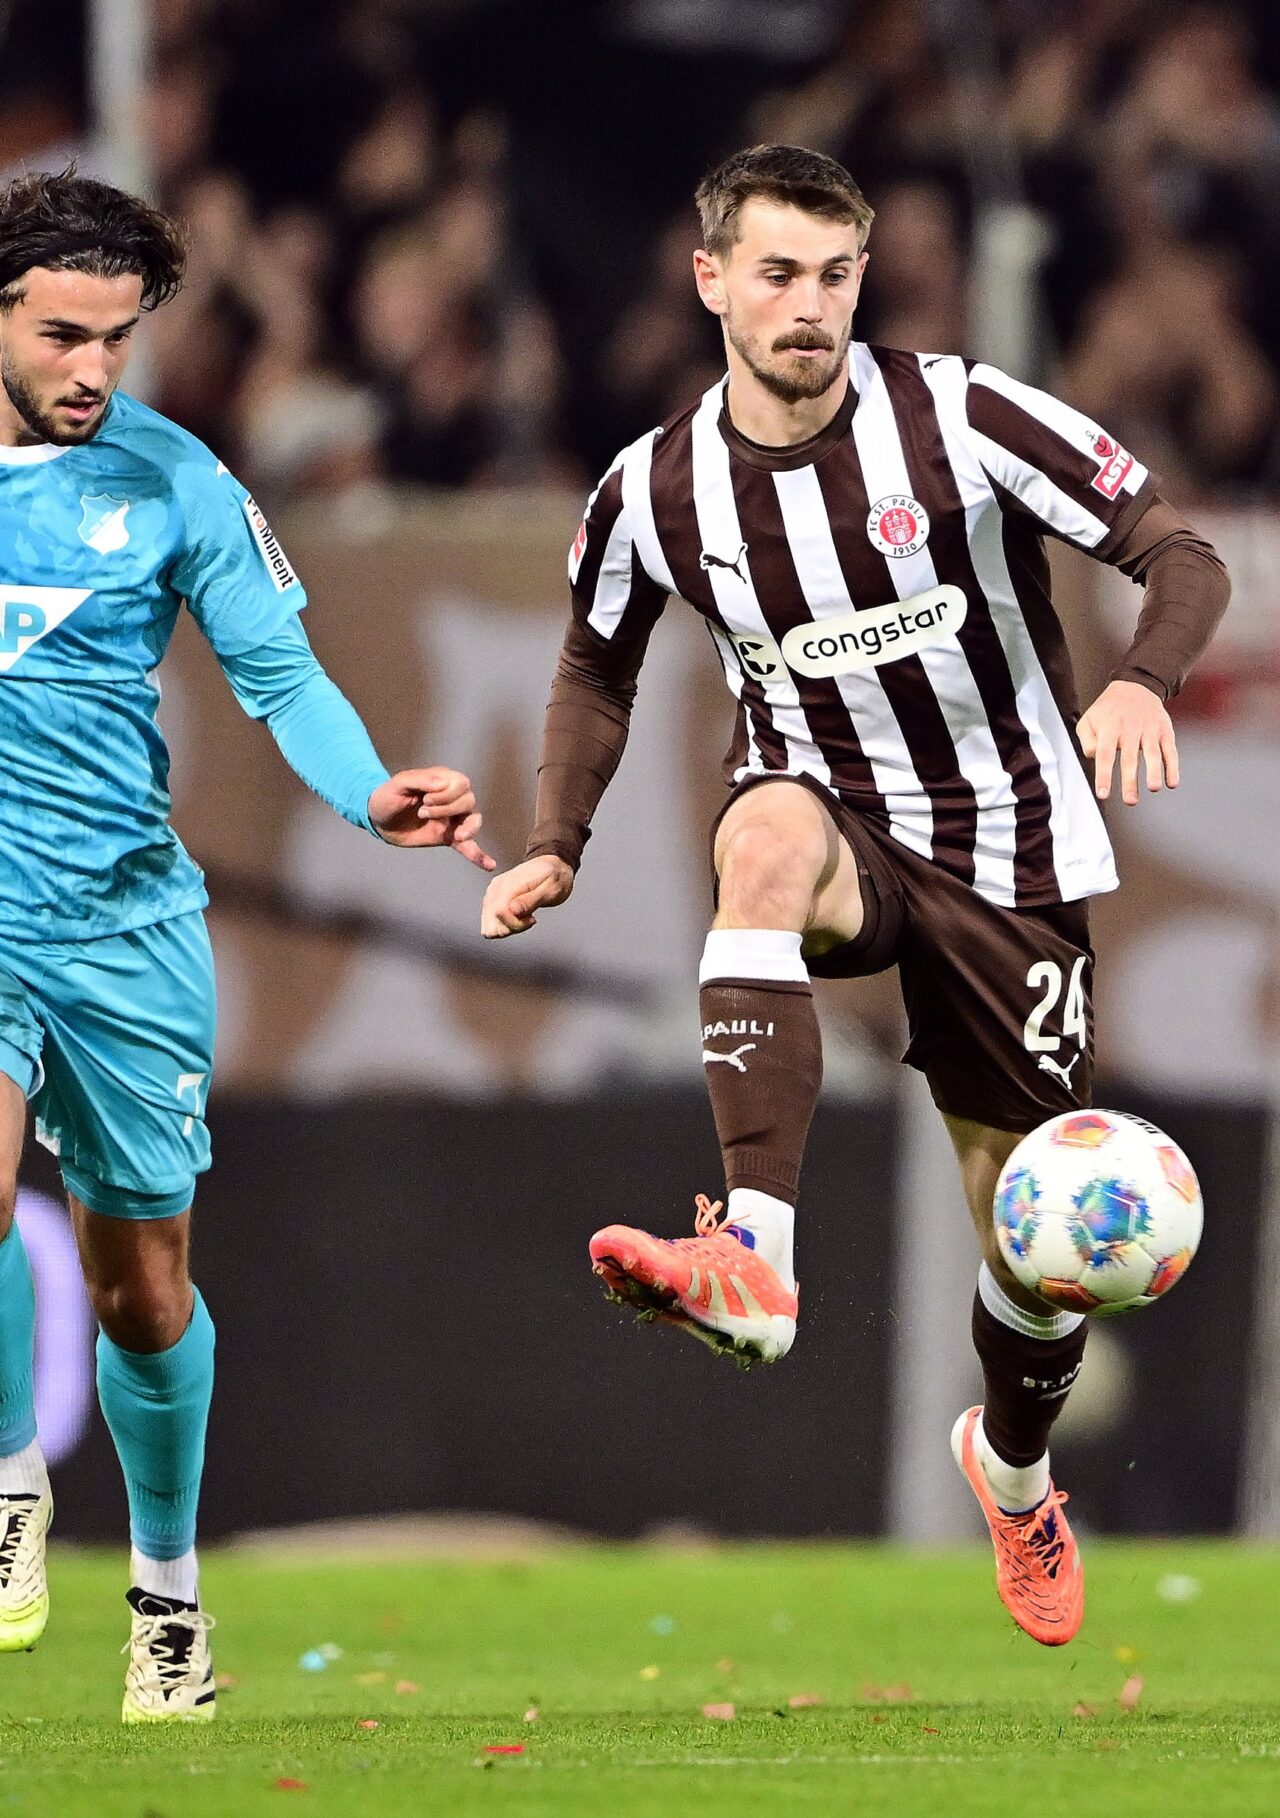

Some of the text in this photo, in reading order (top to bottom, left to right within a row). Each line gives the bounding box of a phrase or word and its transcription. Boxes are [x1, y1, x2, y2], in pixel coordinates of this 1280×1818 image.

[869, 498, 924, 532] FC ST. PAULI
[893, 542, 917, 556] 1910
[802, 601, 948, 660] congstar
[1024, 955, 1087, 1051] 24
[176, 1072, 207, 1136] 7
